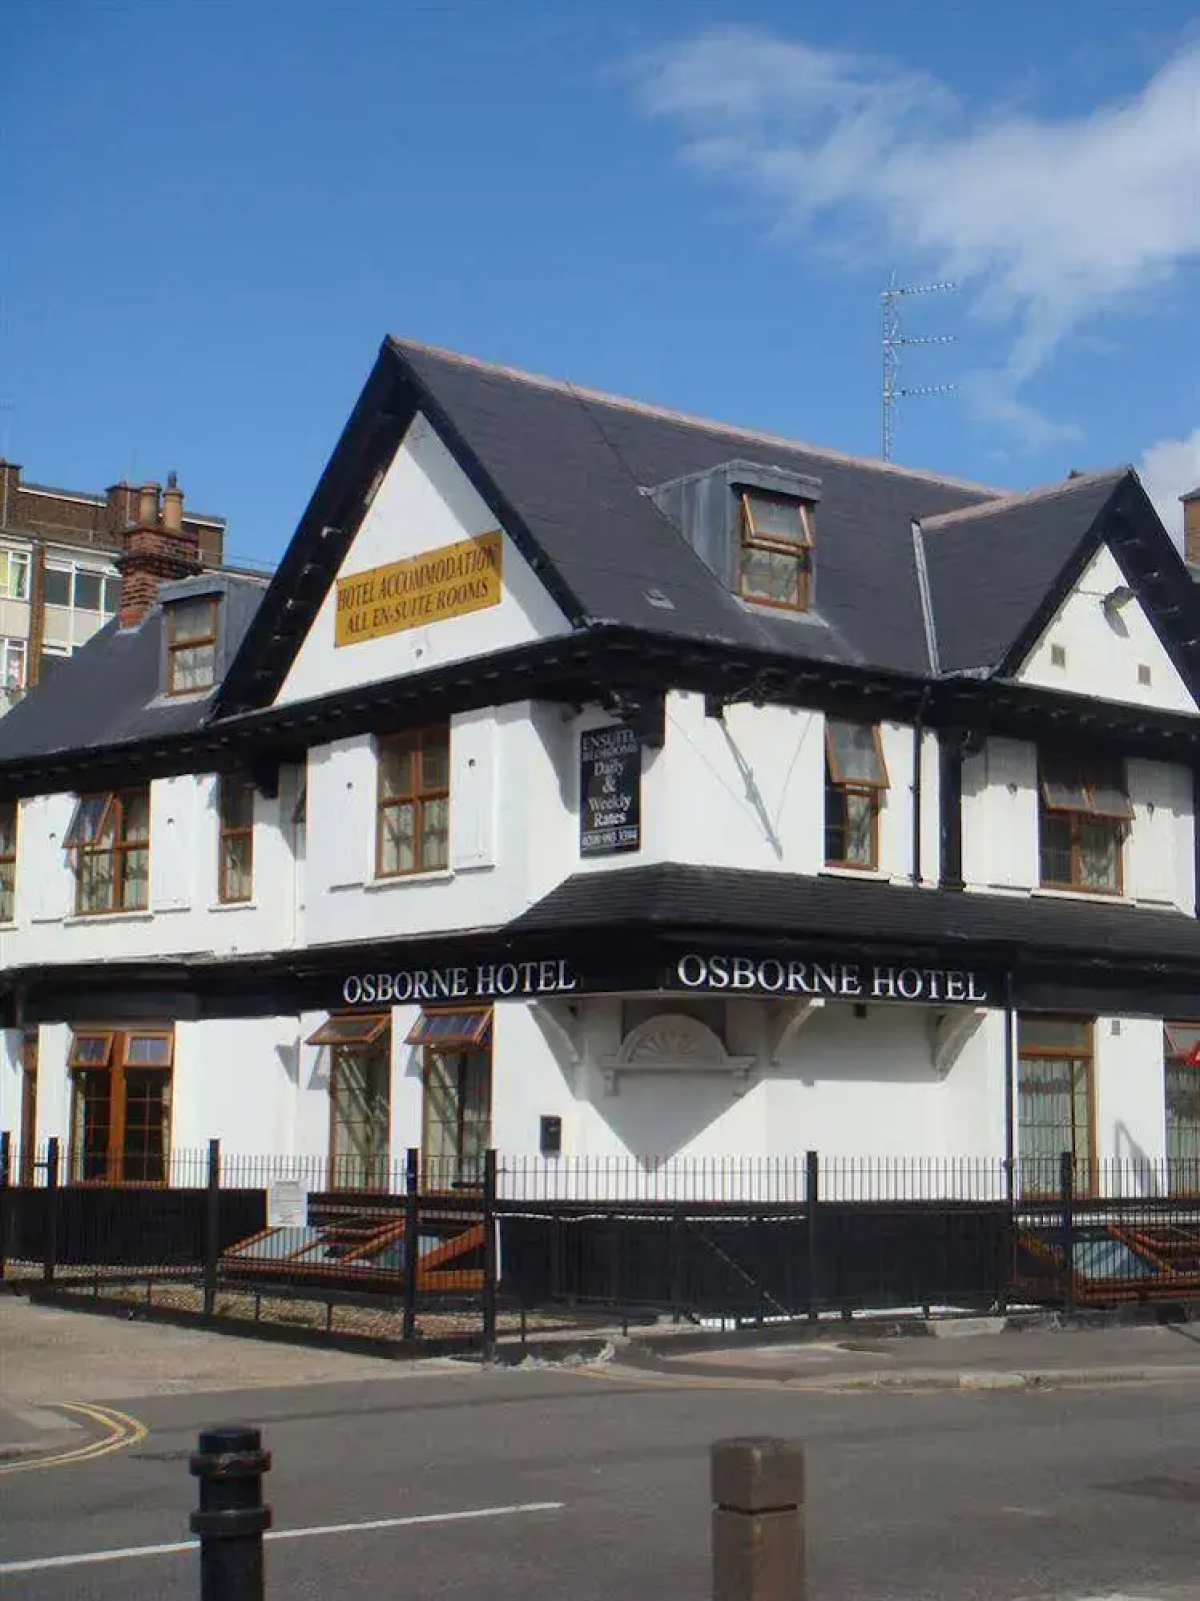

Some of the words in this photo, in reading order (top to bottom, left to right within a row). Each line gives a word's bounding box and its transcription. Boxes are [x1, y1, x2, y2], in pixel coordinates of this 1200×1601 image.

[337, 581, 376, 612] HOTEL
[378, 544, 499, 599] ACCOMMODATION
[346, 612, 369, 635] ALL
[436, 576, 490, 610] ROOMS
[602, 775, 616, 793] &
[343, 967, 469, 1004] OSBORNE
[475, 959, 577, 996] HOTEL
[677, 954, 863, 995] OSBORNE
[871, 966, 988, 1001] HOTEL
